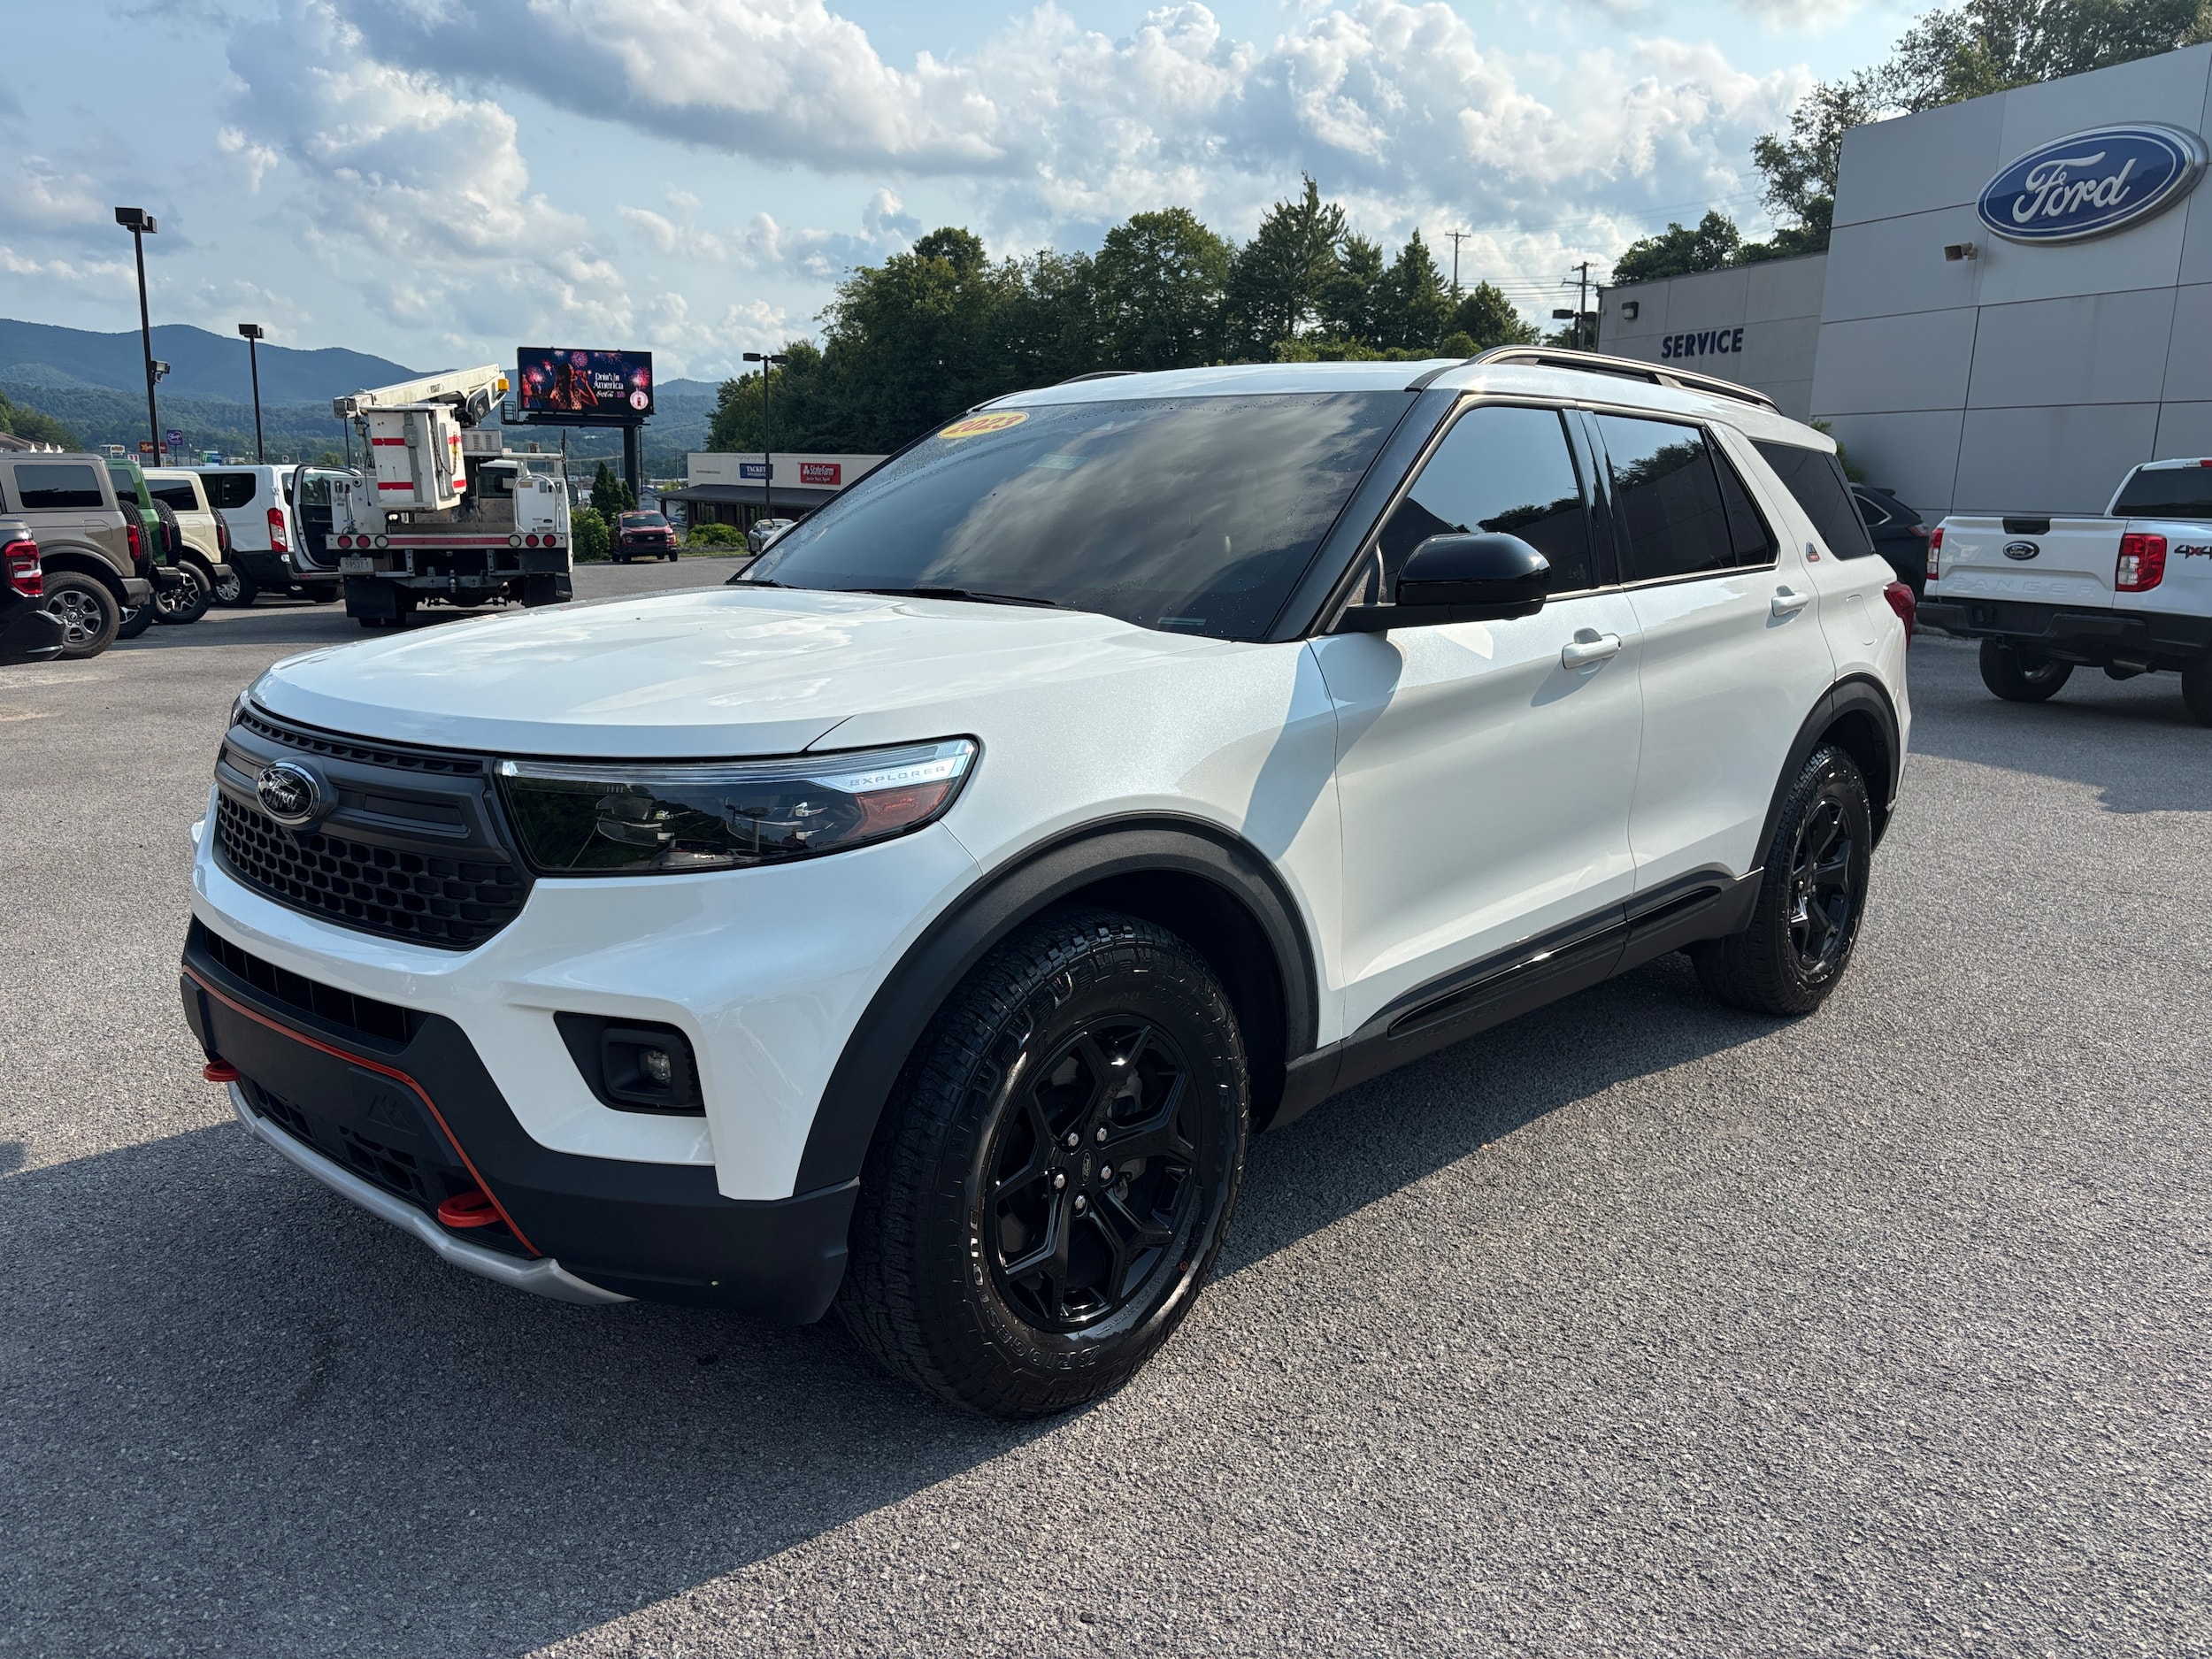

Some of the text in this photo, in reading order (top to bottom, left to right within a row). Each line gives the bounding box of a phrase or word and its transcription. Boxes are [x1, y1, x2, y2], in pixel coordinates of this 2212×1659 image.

[2012, 151, 2137, 223] Ford
[1661, 328, 1744, 358] SERVICE
[593, 380, 624, 390] America
[941, 415, 1025, 436] 2023
[1951, 578, 2096, 597] RANGER
[850, 766, 946, 787] EXPLORER
[265, 772, 300, 811] Ford
[970, 1209, 1101, 1371] BRIDGESTONE
